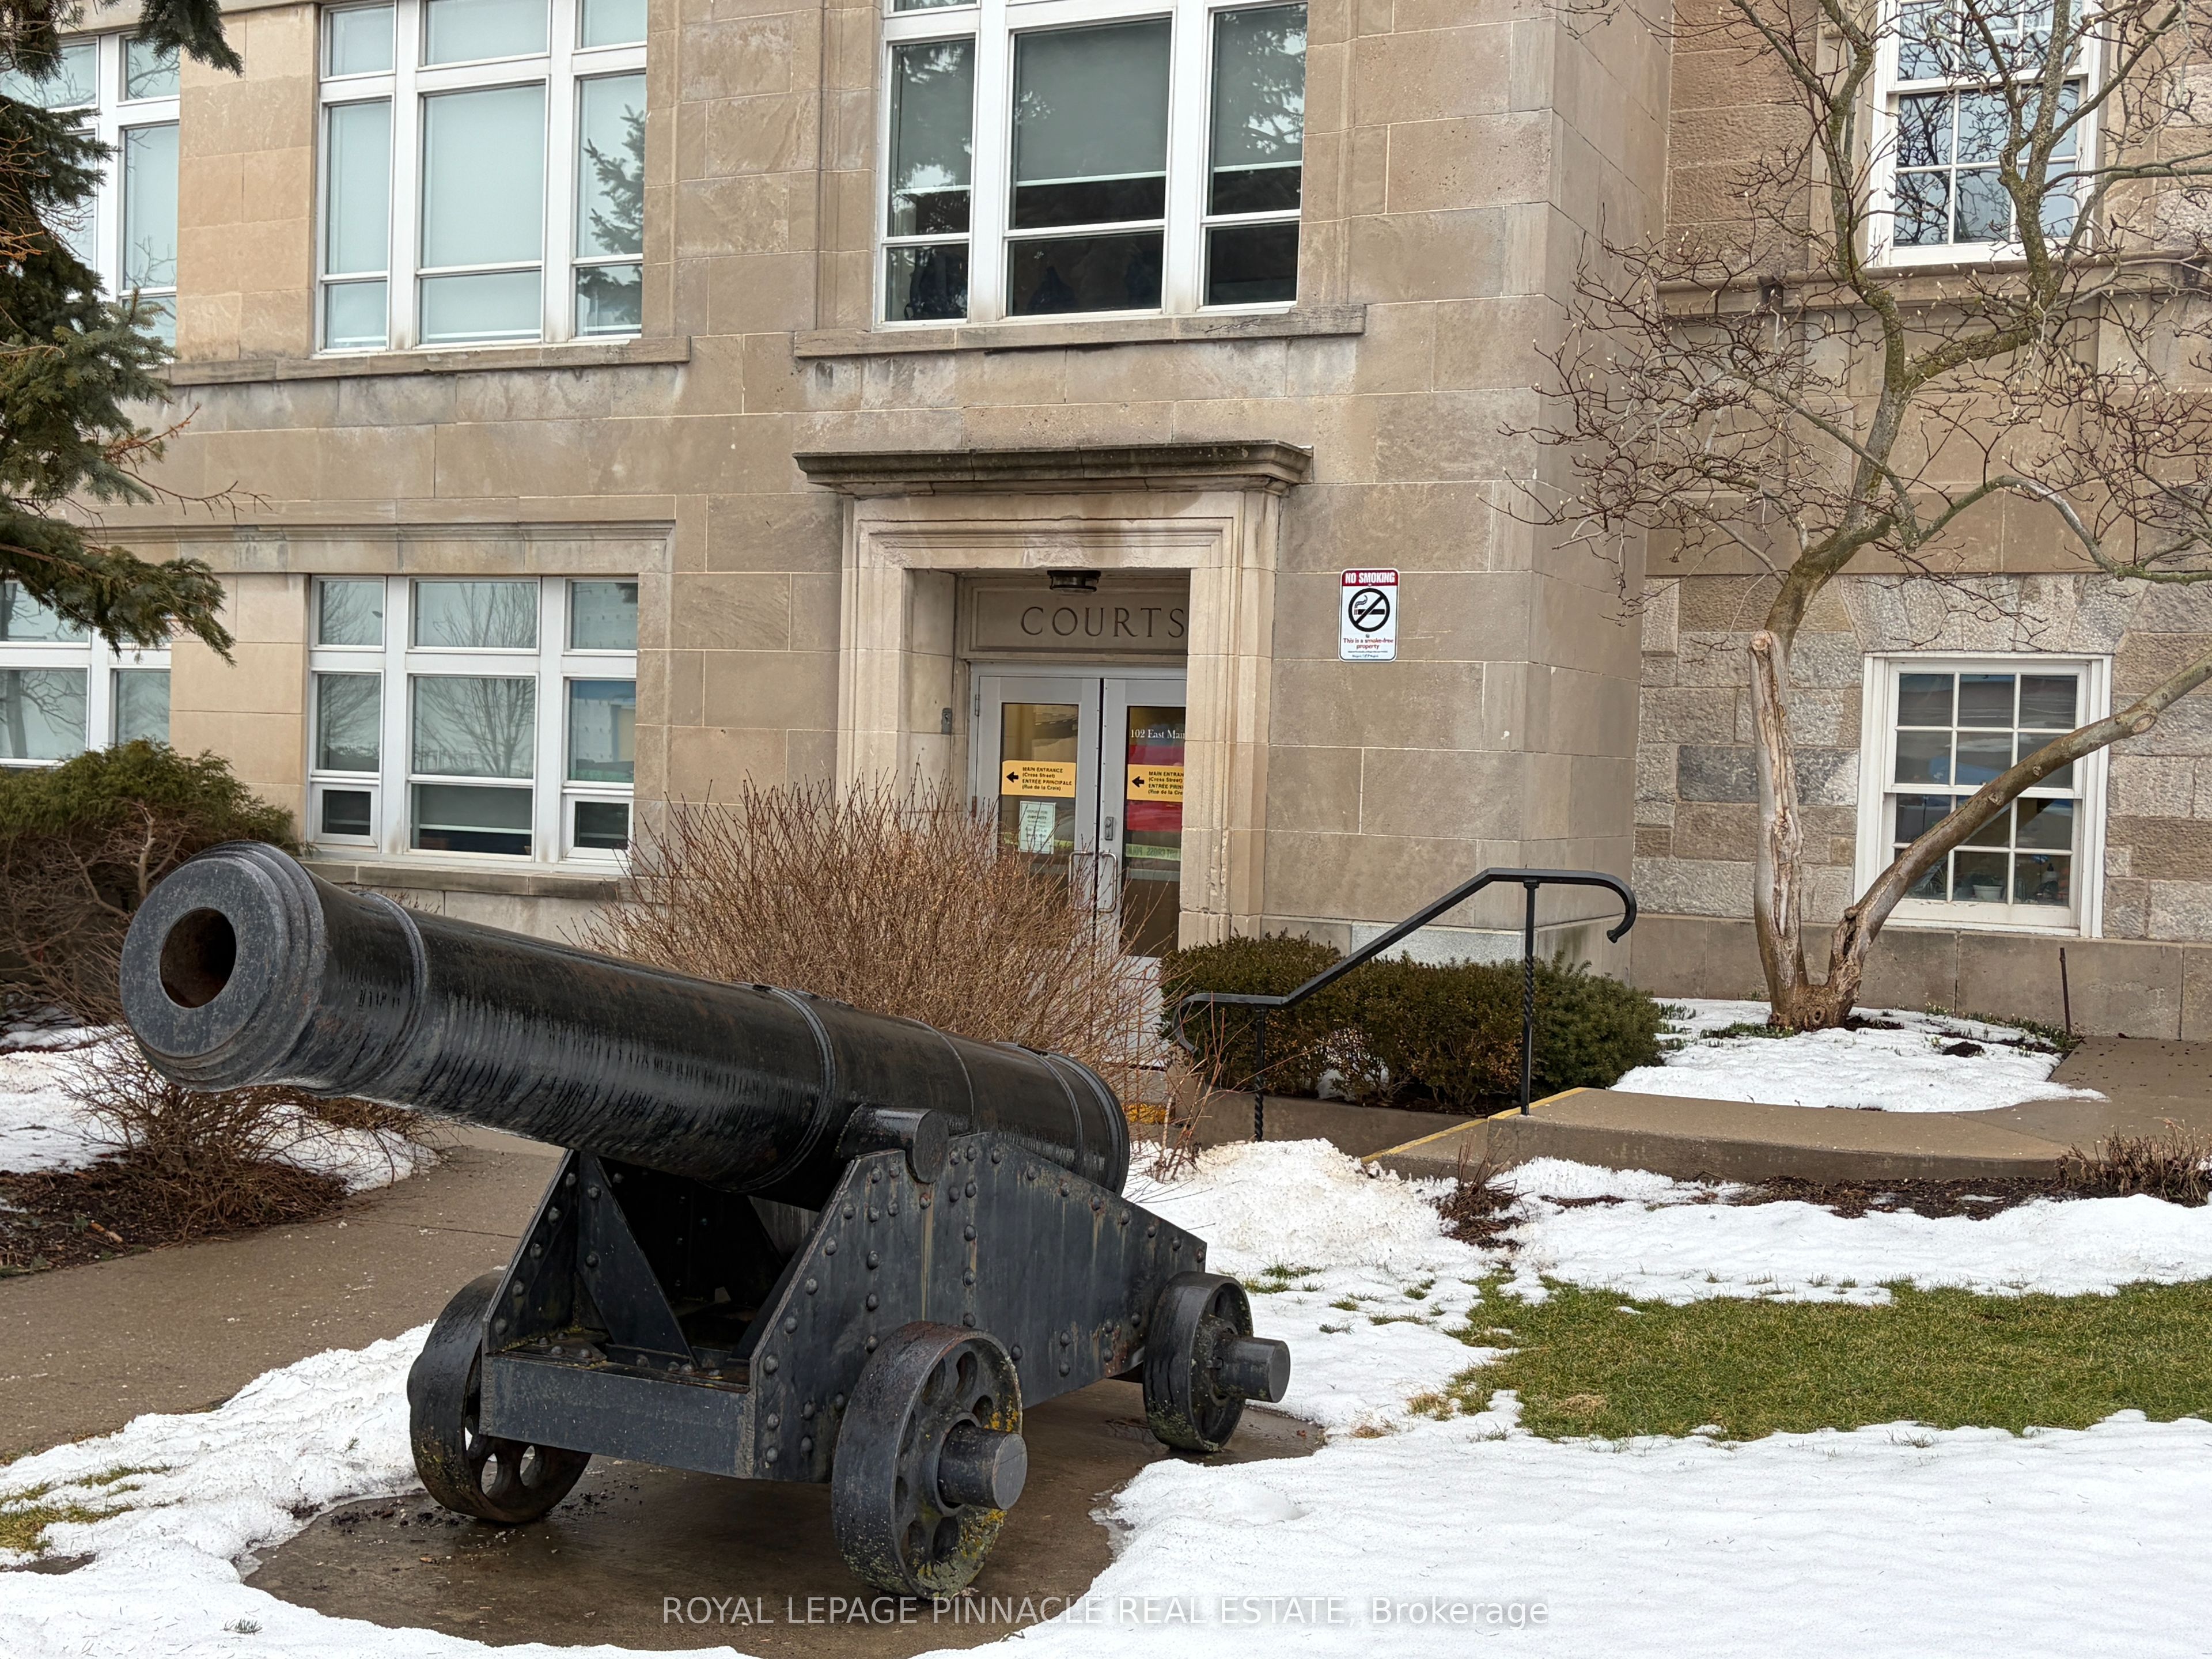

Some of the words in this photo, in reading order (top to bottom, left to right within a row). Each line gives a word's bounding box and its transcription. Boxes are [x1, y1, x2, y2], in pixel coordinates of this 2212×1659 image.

[1345, 573, 1357, 584] NO
[1358, 572, 1395, 584] SMOKING
[1020, 606, 1185, 638] COURTS
[1131, 729, 1145, 738] 102
[1147, 729, 1164, 738] East
